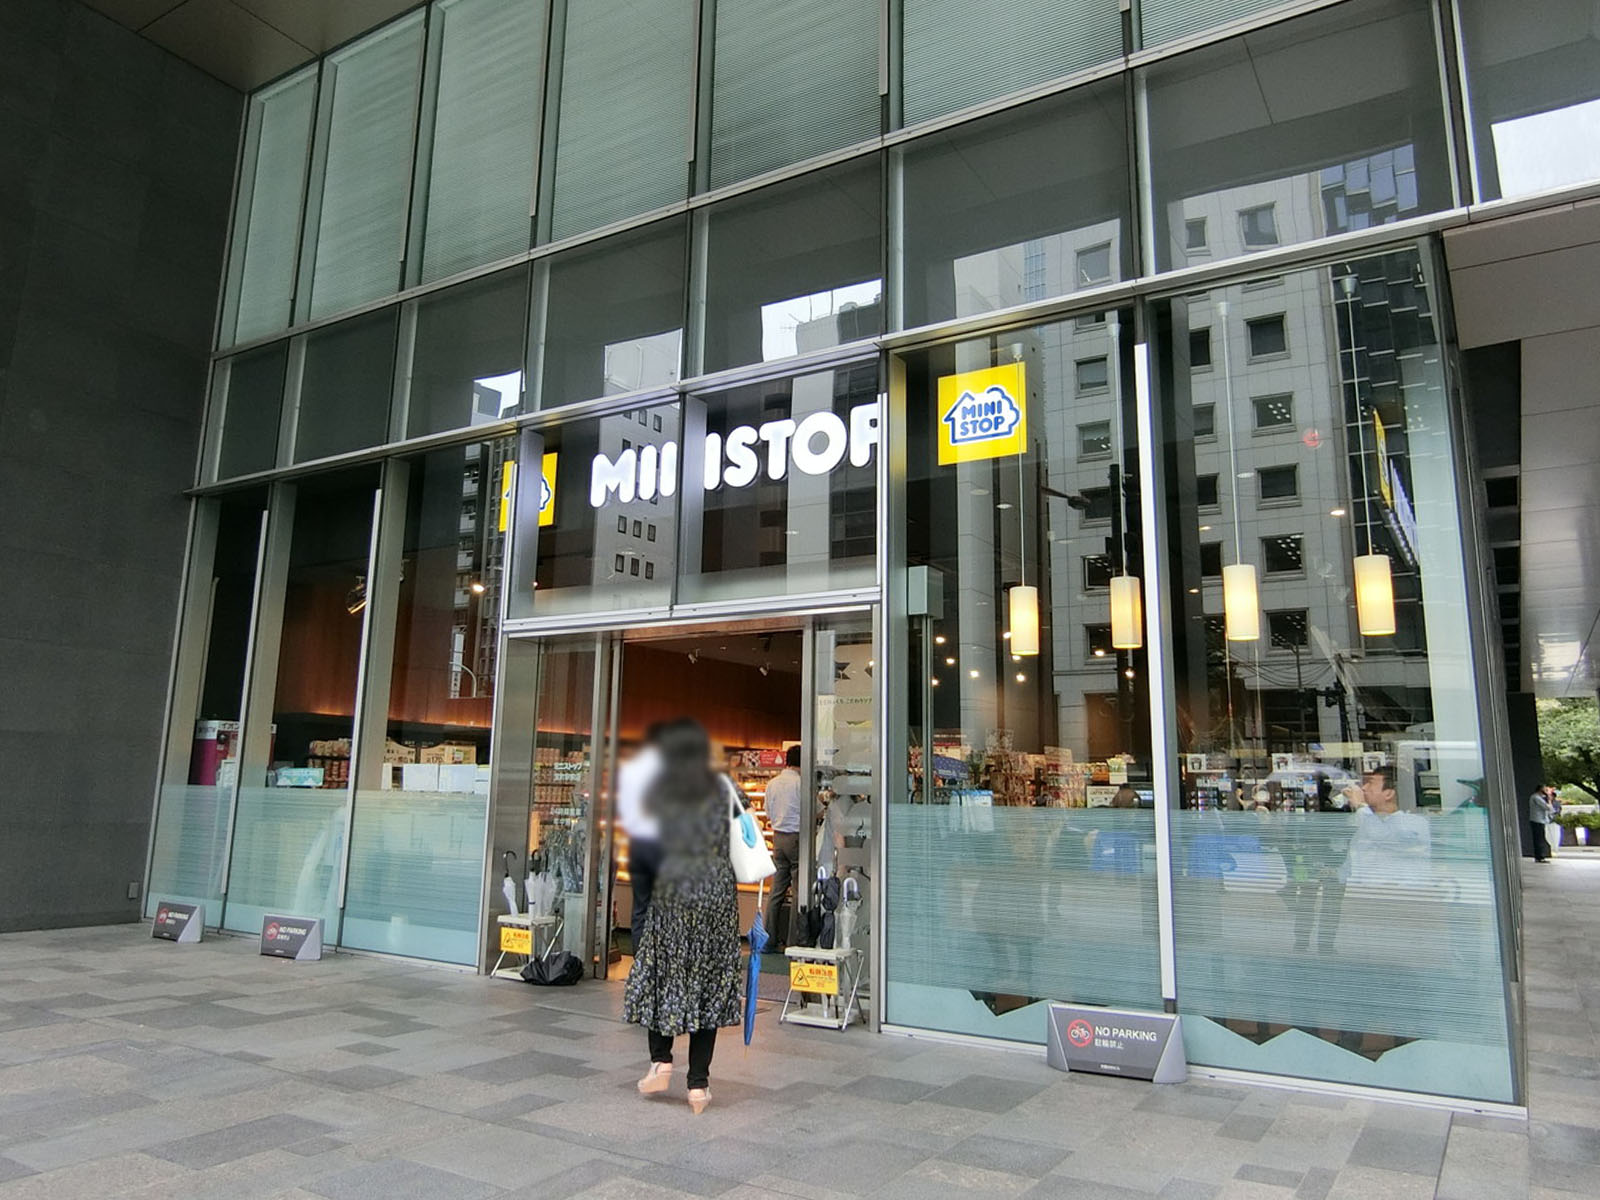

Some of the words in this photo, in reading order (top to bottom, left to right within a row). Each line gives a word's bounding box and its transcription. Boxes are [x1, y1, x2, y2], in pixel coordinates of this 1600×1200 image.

[961, 400, 1003, 420] MINI
[959, 415, 1005, 436] STOP
[1094, 1025, 1110, 1037] NO
[1111, 1027, 1157, 1042] PARKING
